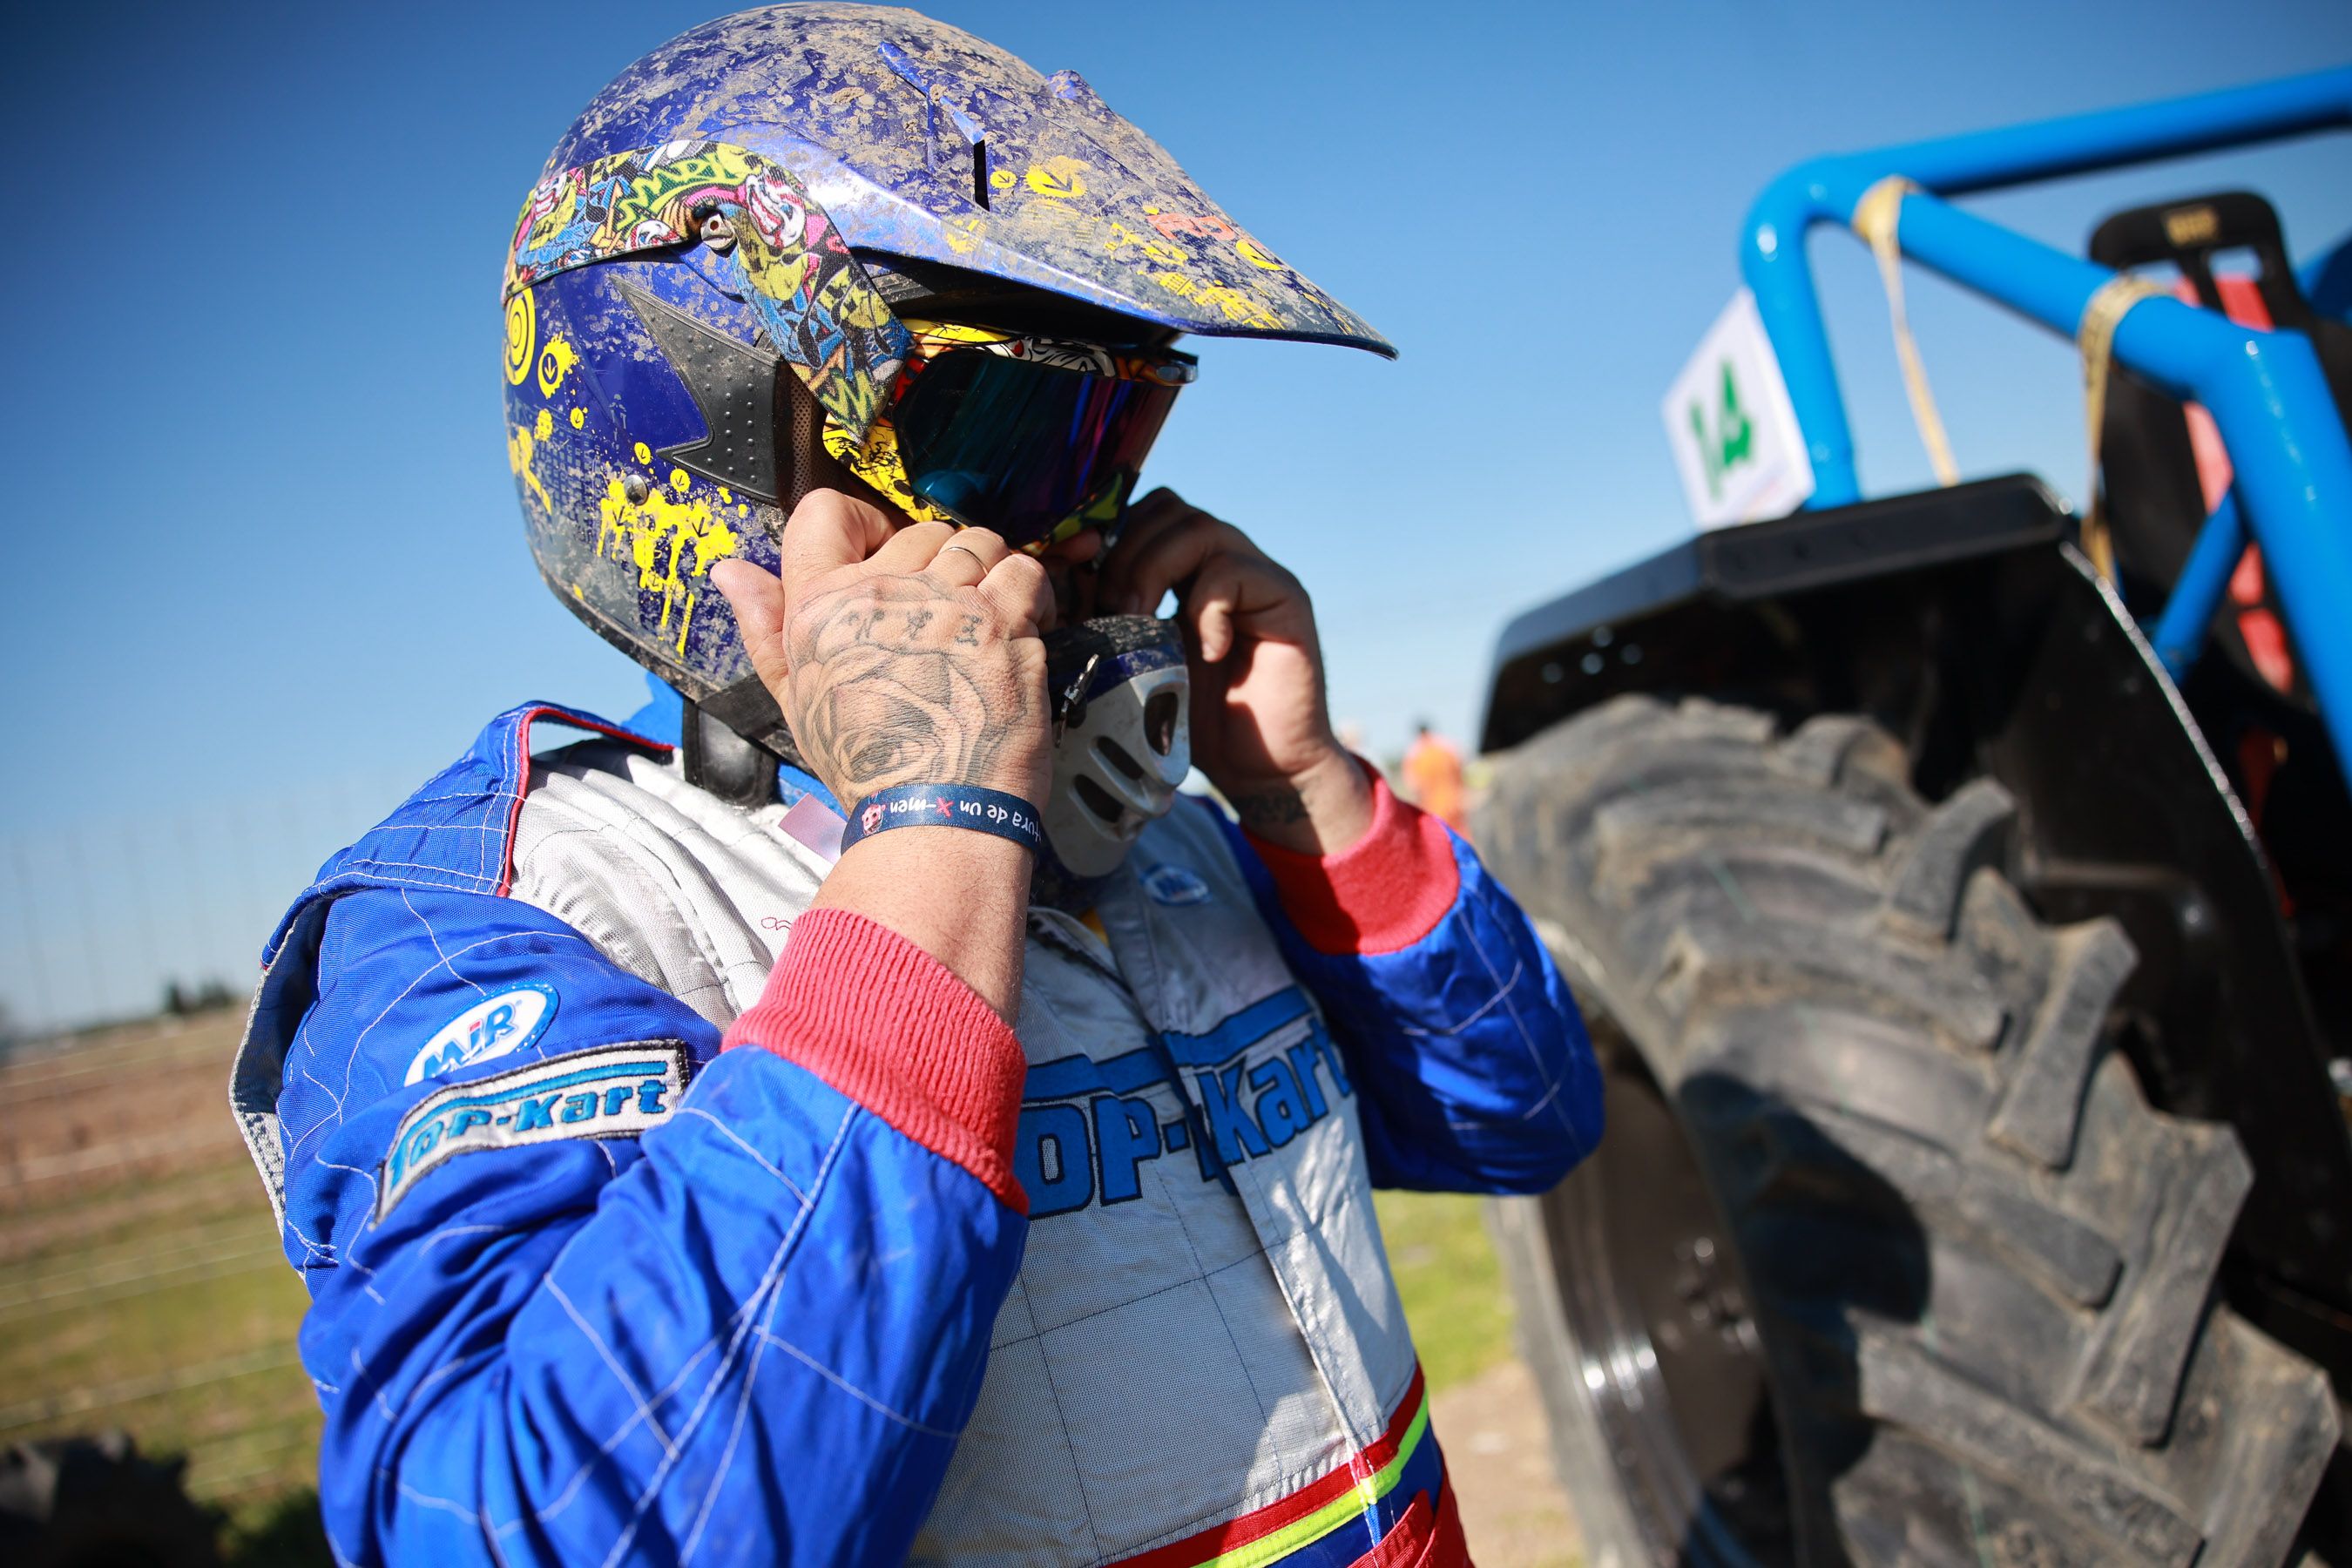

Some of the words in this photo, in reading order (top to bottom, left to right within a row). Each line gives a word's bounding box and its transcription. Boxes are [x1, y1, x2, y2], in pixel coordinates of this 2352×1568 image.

[987, 805, 1008, 824] de
[1012, 811, 1041, 842] tura
[1019, 985, 1352, 1218] OP-Kart
